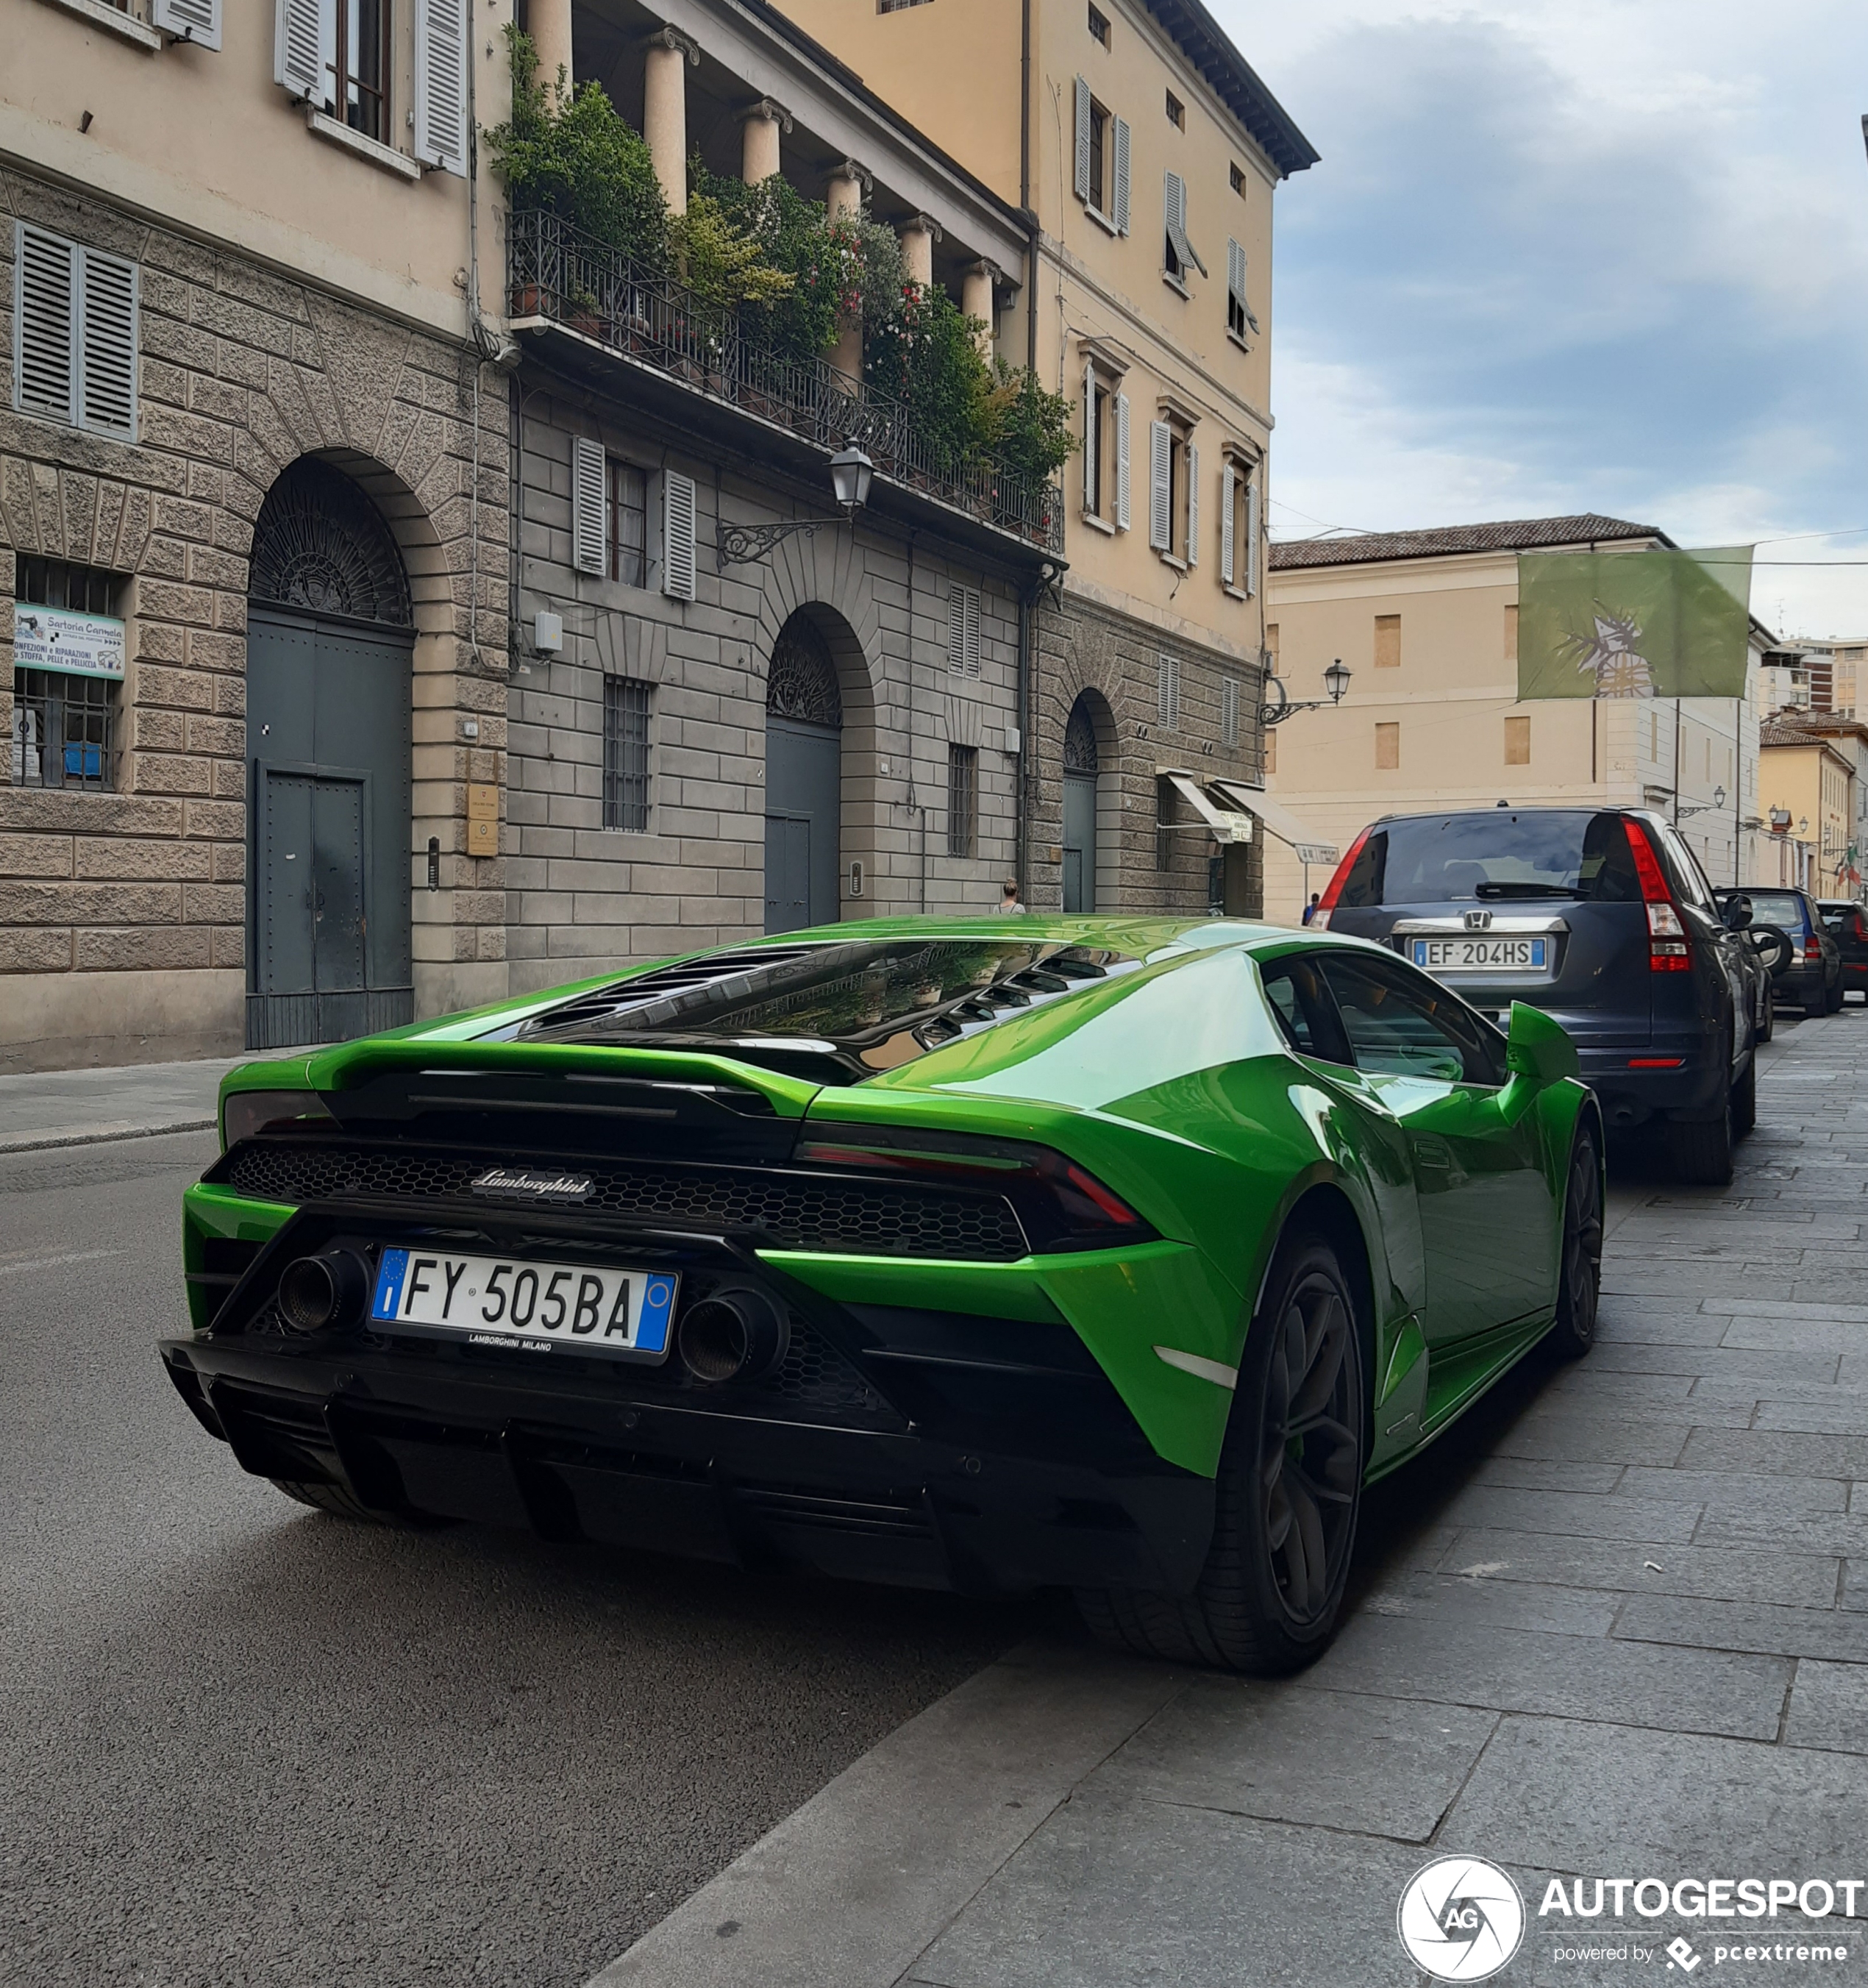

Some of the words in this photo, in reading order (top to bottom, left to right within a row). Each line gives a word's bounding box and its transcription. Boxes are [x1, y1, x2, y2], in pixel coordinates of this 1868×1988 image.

[47, 616, 84, 632] Sartoria
[85, 623, 122, 638] Carmela
[14, 641, 47, 653] ONFEZIONI
[55, 647, 91, 660] RIPARAZIONI
[21, 651, 45, 663] STOFFA,
[47, 655, 64, 664] PELLE
[71, 658, 97, 669] PELLICCIA
[1429, 943, 1454, 964] EF
[1462, 943, 1529, 964] 204HS
[471, 1169, 590, 1195] Lamborghini
[404, 1258, 468, 1319] FY
[482, 1264, 630, 1339] 505BA
[468, 1333, 520, 1347] LAMBORGHINI
[522, 1340, 552, 1352] MILANO
